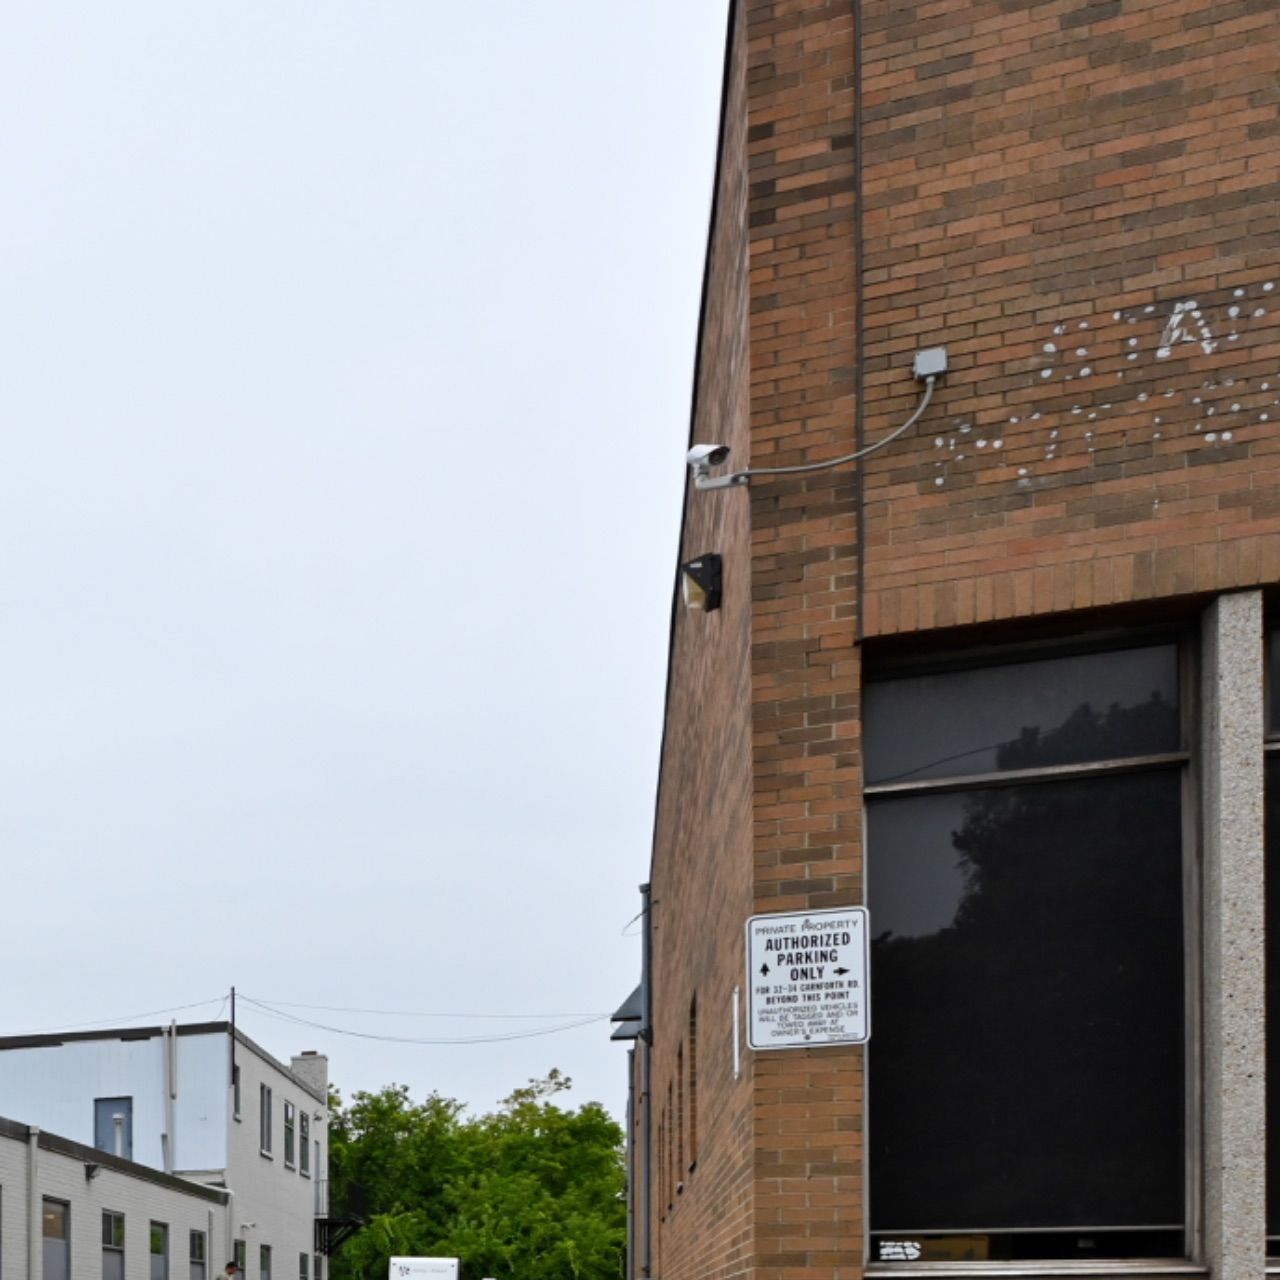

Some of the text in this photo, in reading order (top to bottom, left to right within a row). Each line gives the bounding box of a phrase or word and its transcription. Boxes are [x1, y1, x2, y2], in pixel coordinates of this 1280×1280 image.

[755, 919, 858, 936] PRIVATE PROPERTY
[765, 932, 851, 951] AUTHORIZED
[777, 949, 838, 966] PARKING
[790, 965, 825, 981] ONLY
[755, 987, 770, 995] FOR
[800, 980, 844, 992] CARNFORTH
[847, 980, 859, 989] RD.
[766, 991, 850, 1005] BEYOND THIS POINT
[757, 1003, 858, 1015] UNAUTHORIZED VEHICLES
